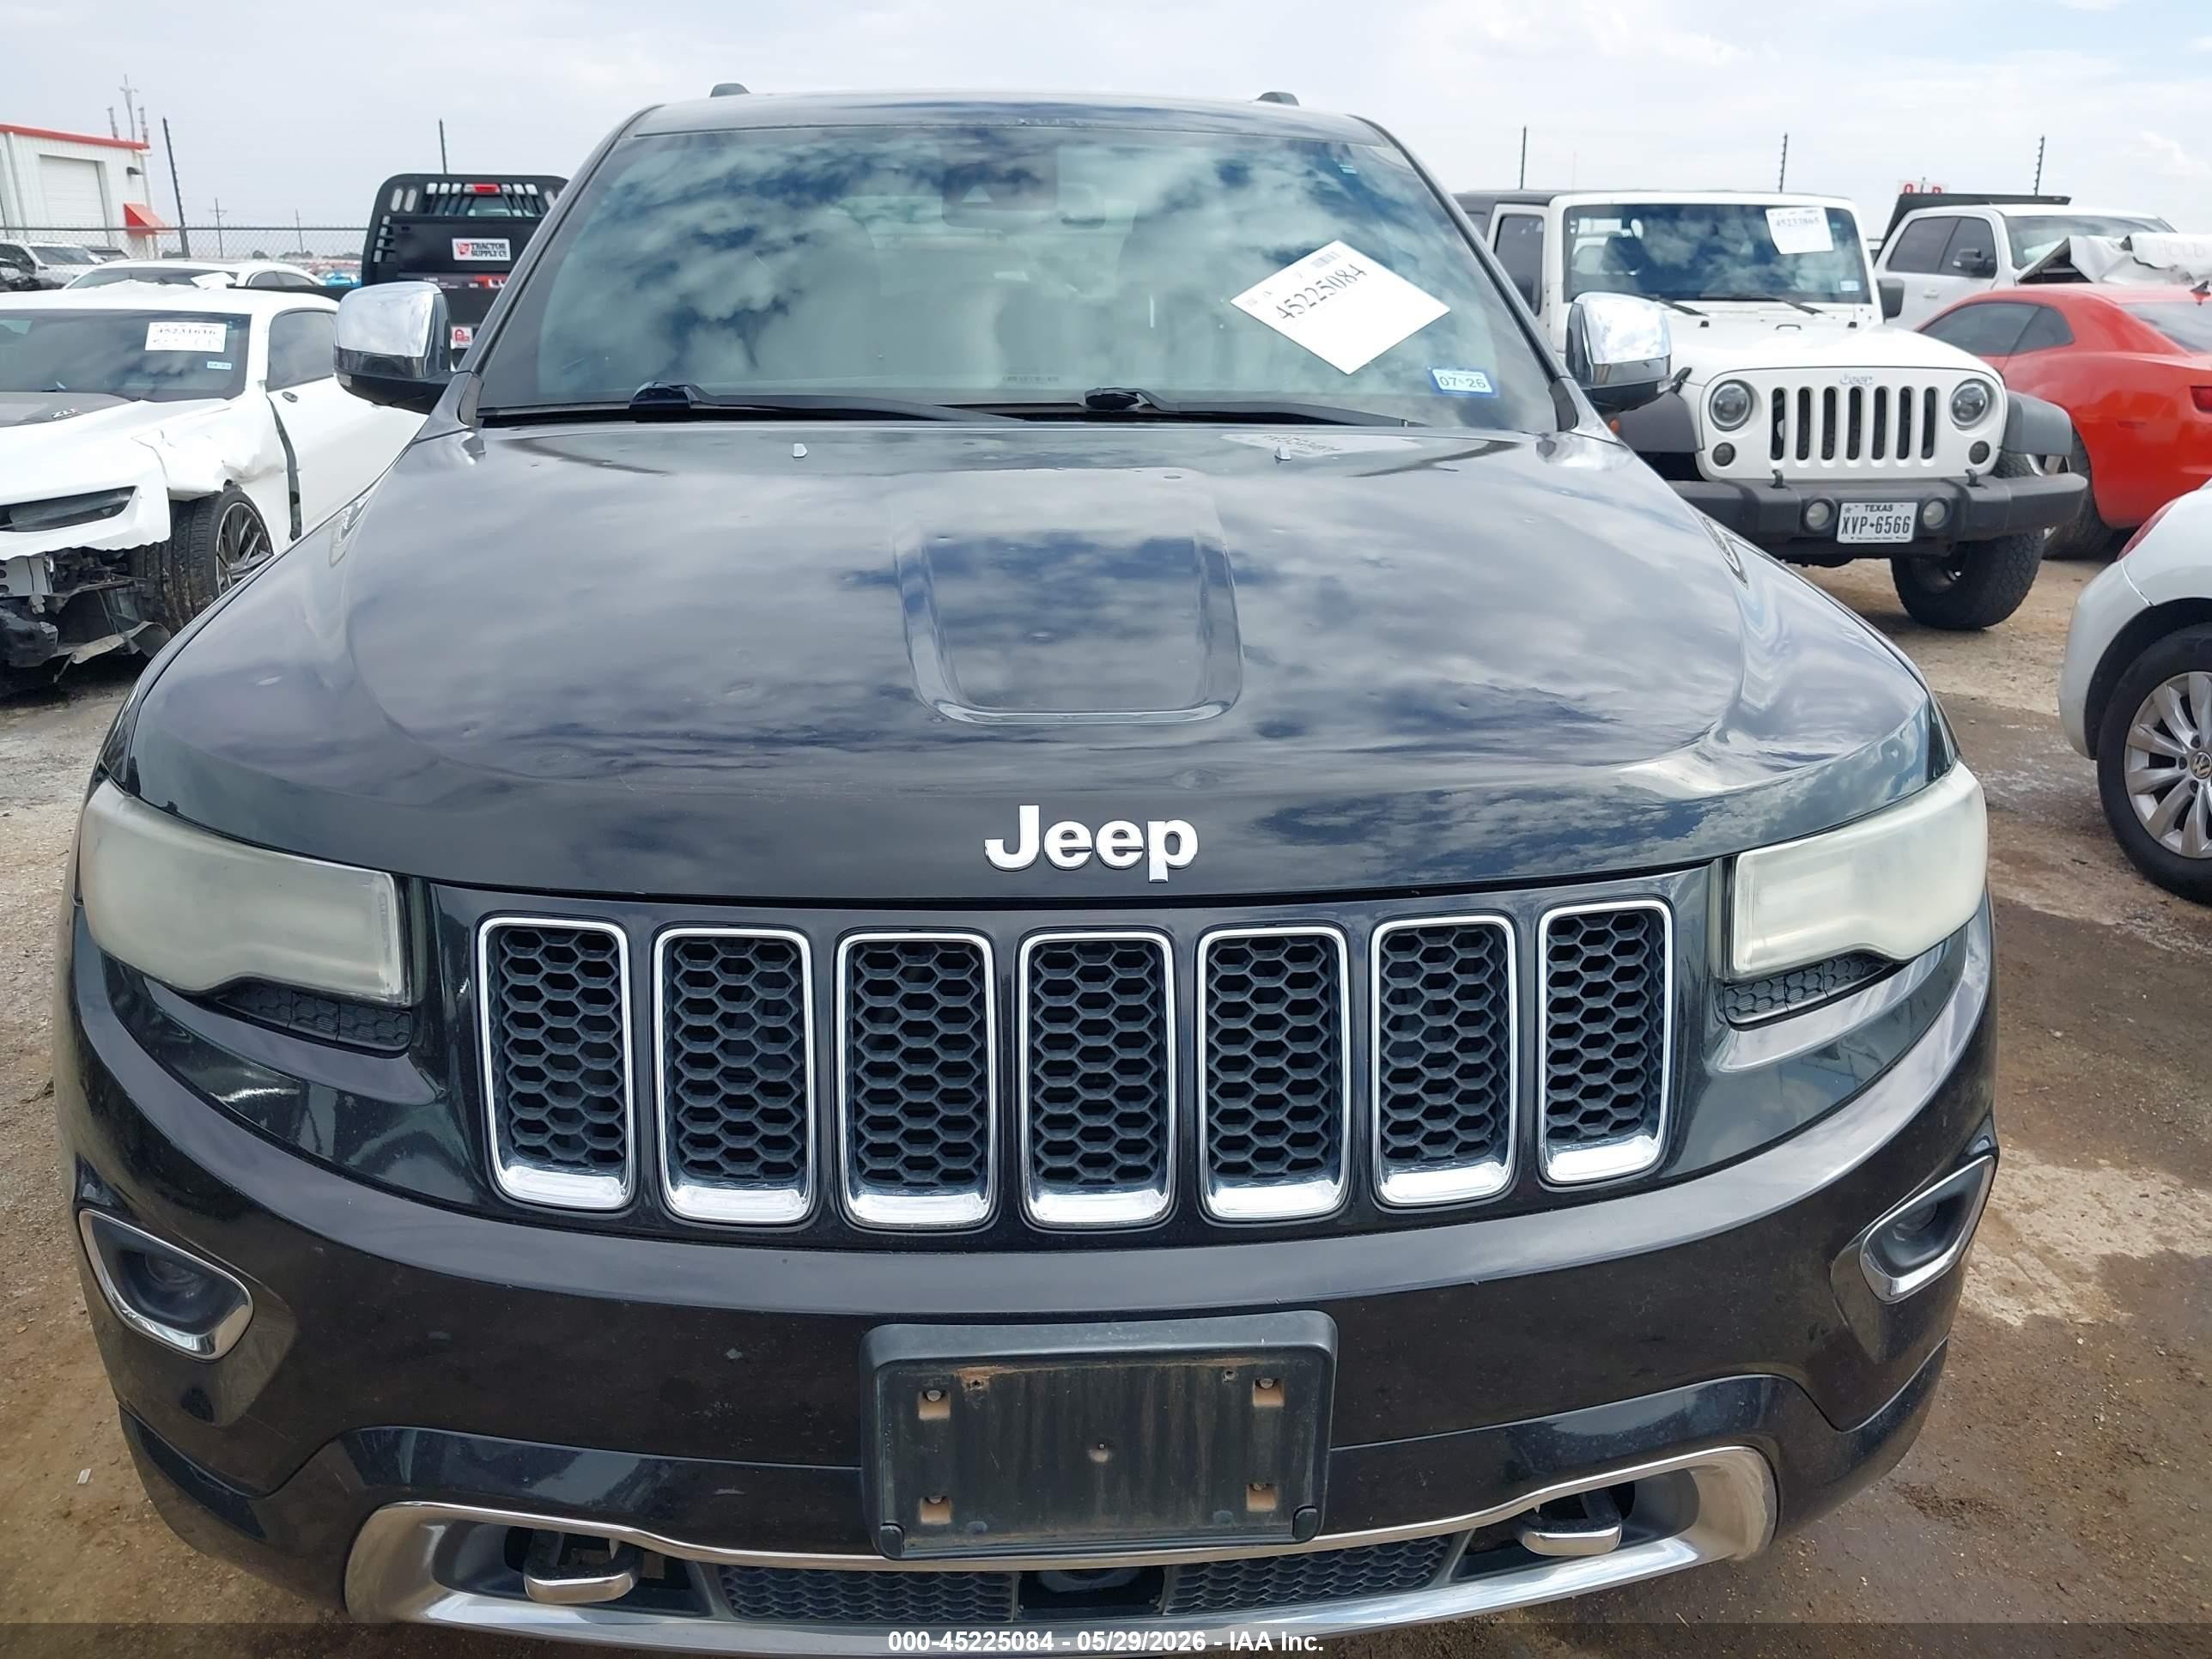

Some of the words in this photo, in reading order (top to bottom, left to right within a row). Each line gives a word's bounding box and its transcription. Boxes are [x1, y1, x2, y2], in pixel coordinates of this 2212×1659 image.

[1275, 264, 1368, 319] 45225084
[1439, 376, 1457, 386] 07
[1465, 378, 1486, 388] 26
[1839, 372, 1874, 387] Jeep
[1864, 503, 1894, 514] TEXAS
[984, 805, 1199, 883] Jeep
